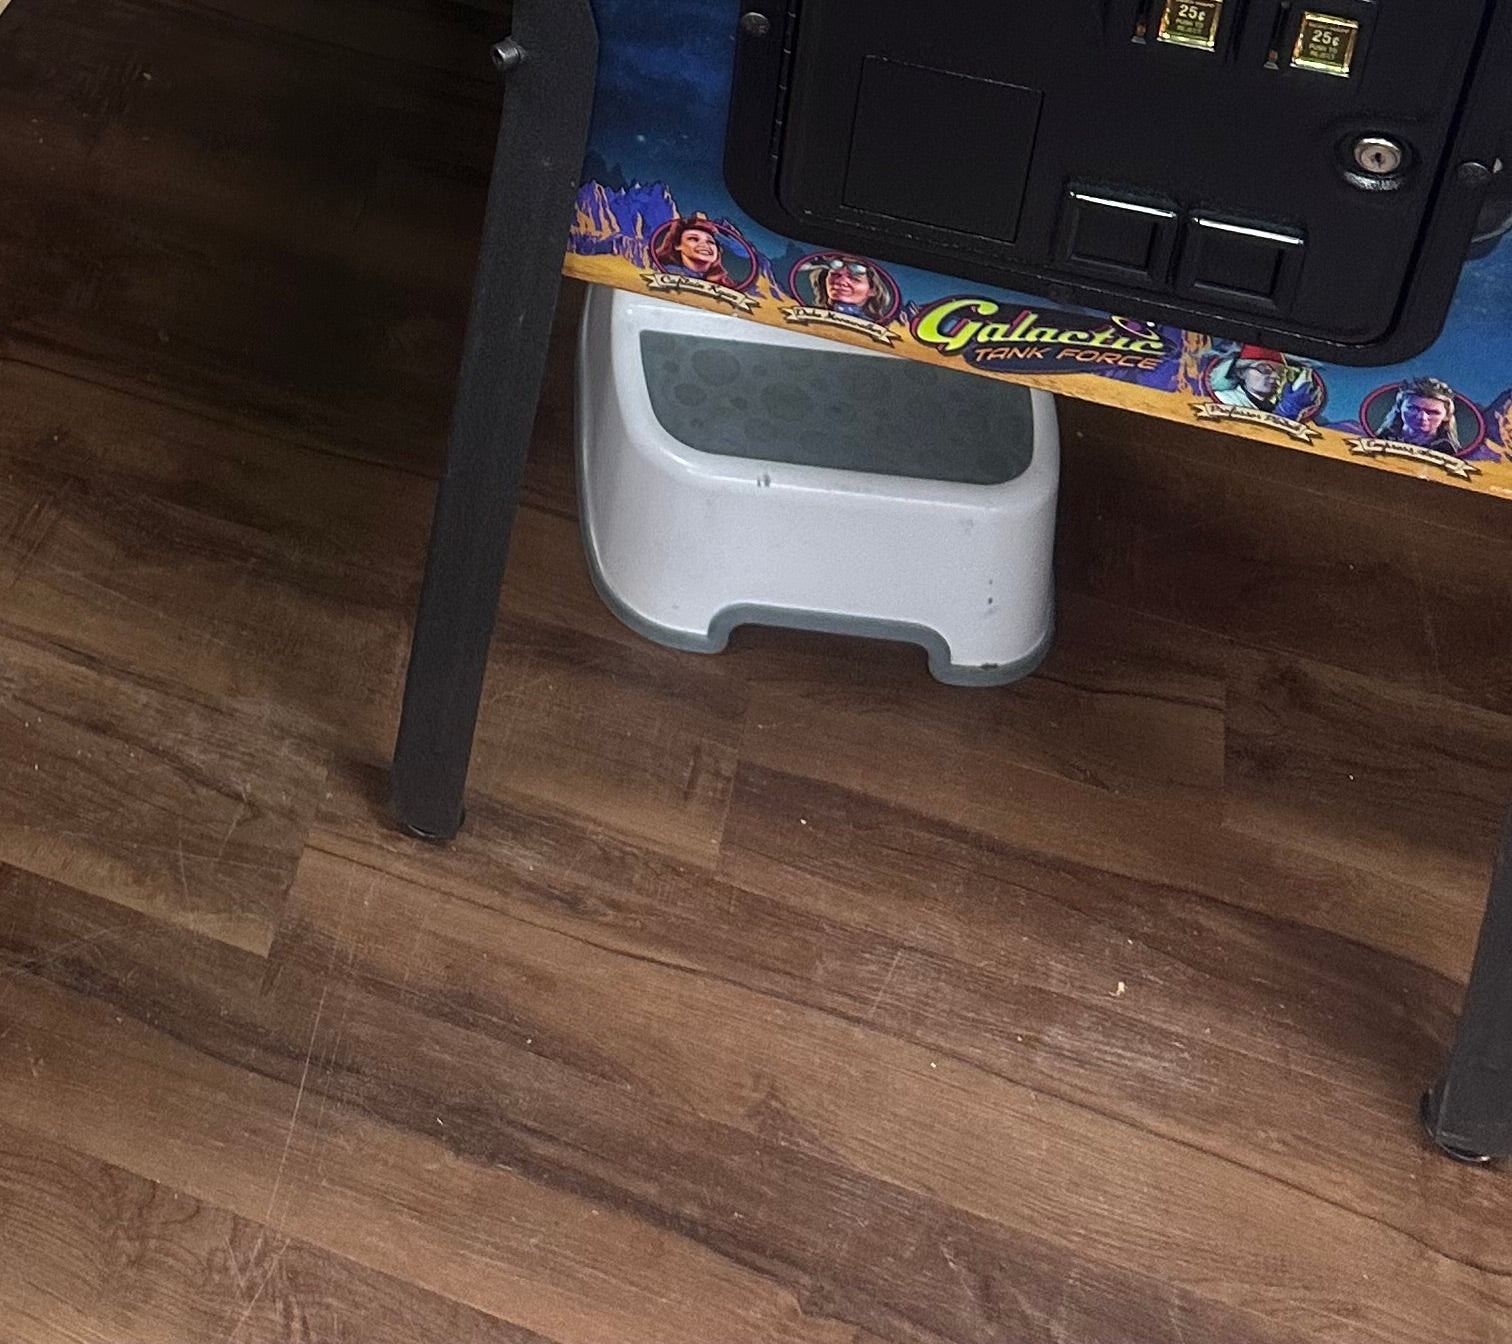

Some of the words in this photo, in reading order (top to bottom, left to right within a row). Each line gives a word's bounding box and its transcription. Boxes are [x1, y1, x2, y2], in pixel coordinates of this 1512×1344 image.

[1178, 3, 1206, 22] 25¢
[1311, 29, 1340, 47] 25¢
[915, 298, 1166, 355] Galactic
[973, 347, 1057, 363] TANK
[1057, 348, 1163, 370] FORCE
